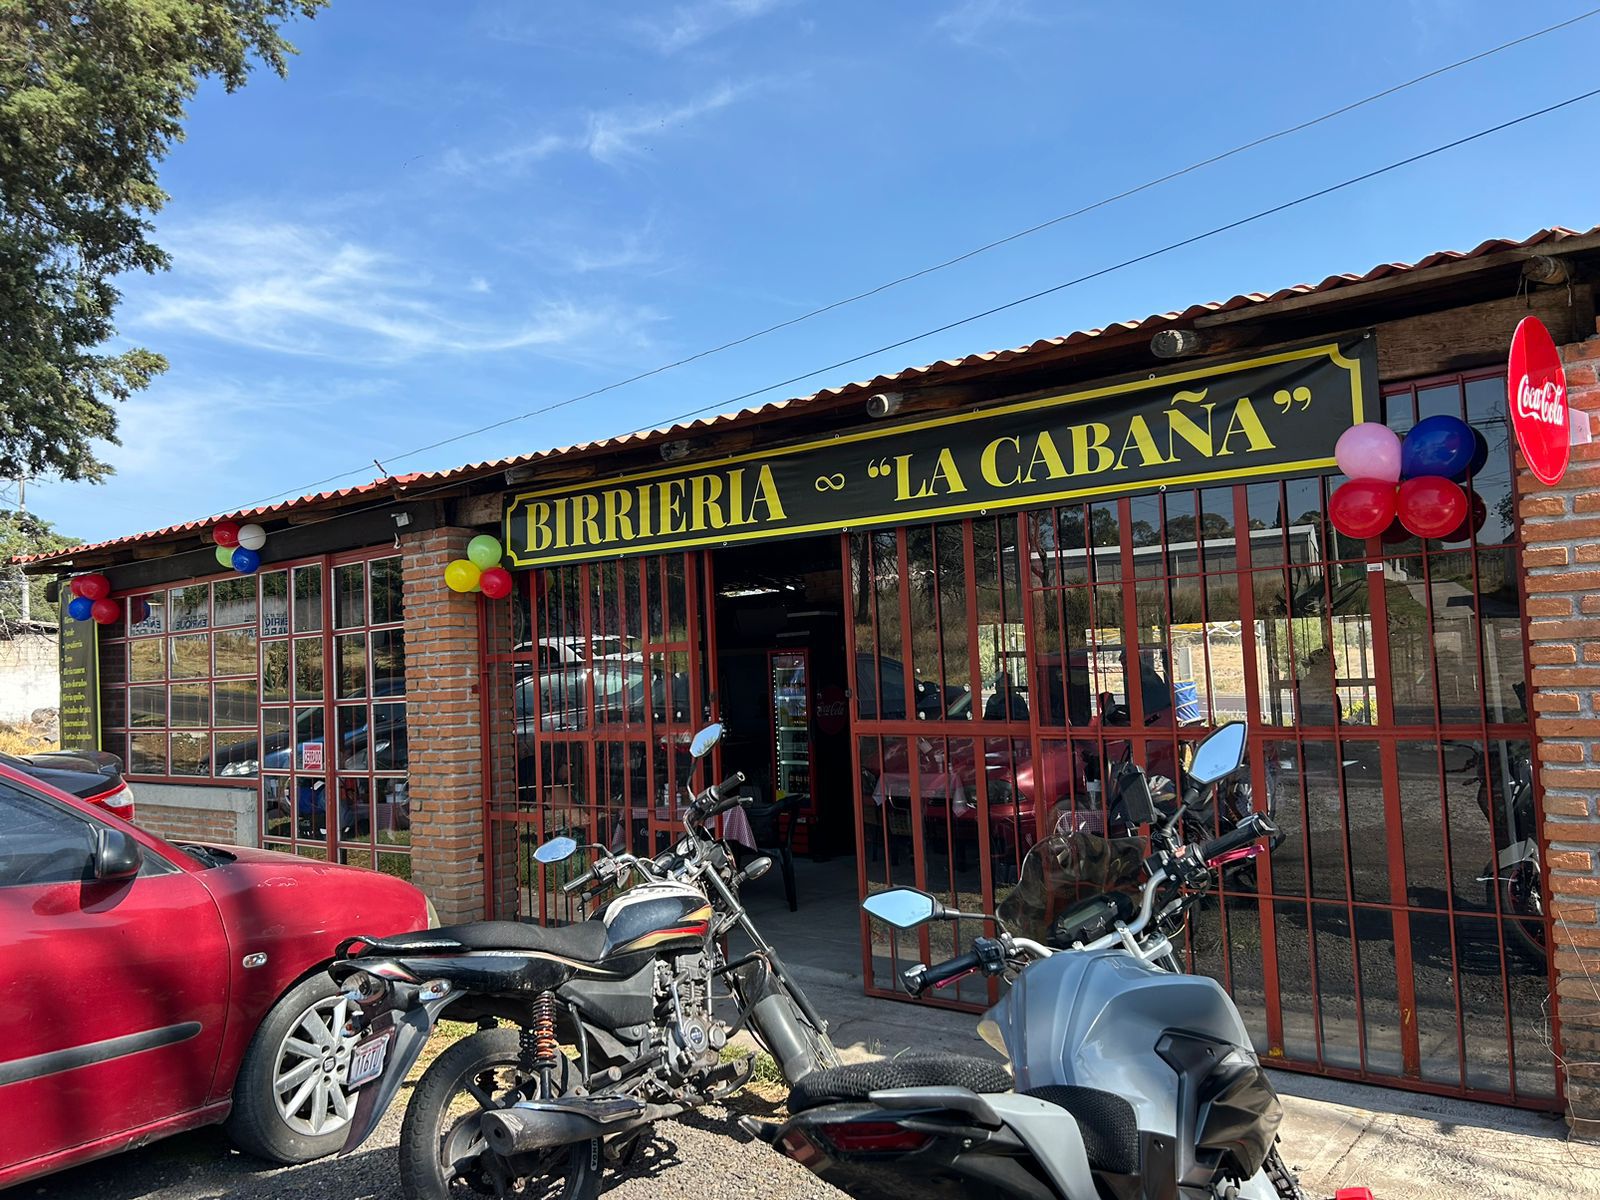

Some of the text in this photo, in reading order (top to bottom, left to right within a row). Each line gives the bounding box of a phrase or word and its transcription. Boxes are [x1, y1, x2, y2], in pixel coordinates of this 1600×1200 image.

[1517, 374, 1564, 426] Coca-Cola
[524, 386, 1312, 553] BIRRIERIA “LA CABAÑA”
